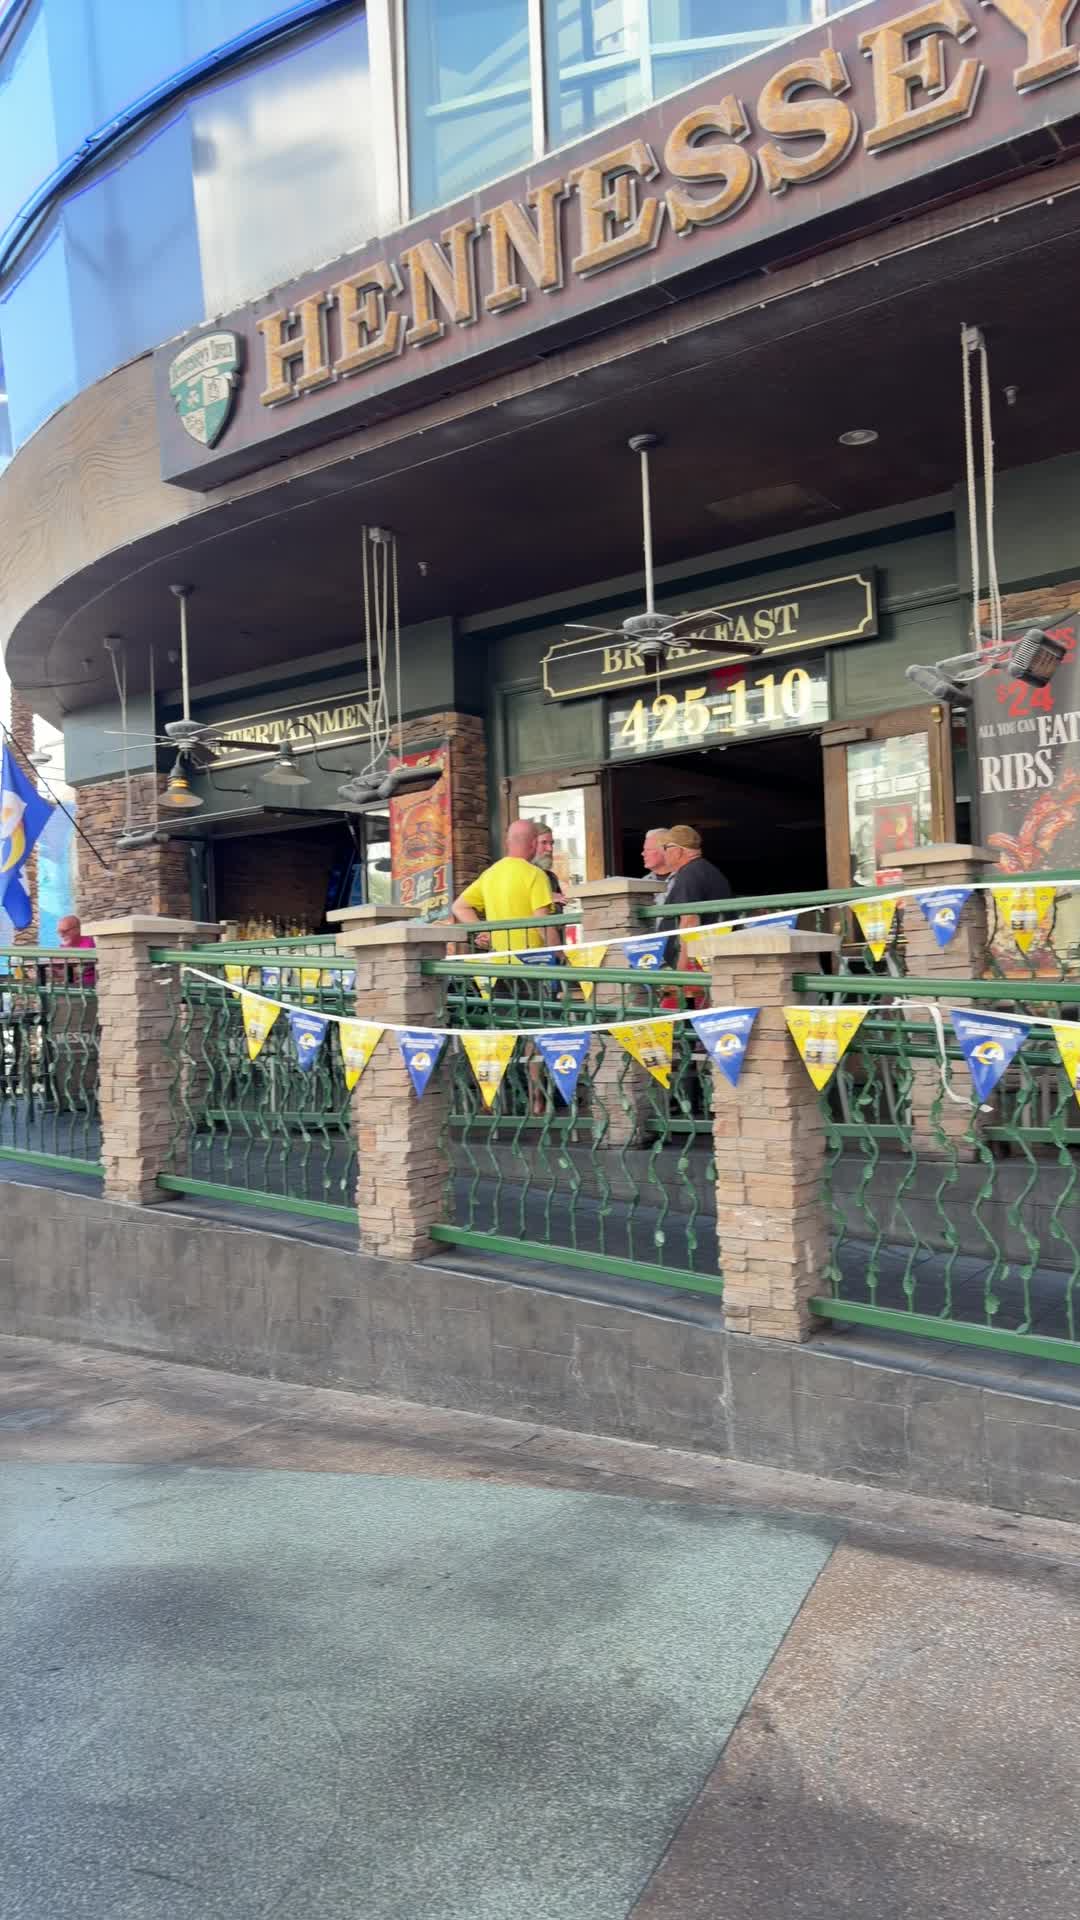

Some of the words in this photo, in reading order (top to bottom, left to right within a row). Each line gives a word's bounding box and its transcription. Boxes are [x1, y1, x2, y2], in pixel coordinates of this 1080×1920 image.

[620, 667, 812, 746] 425-110
[979, 724, 996, 738] ALL
[1036, 711, 1080, 747] EAT
[979, 749, 1054, 795] RIBS
[401, 877, 415, 904] 2
[433, 866, 448, 892] 1
